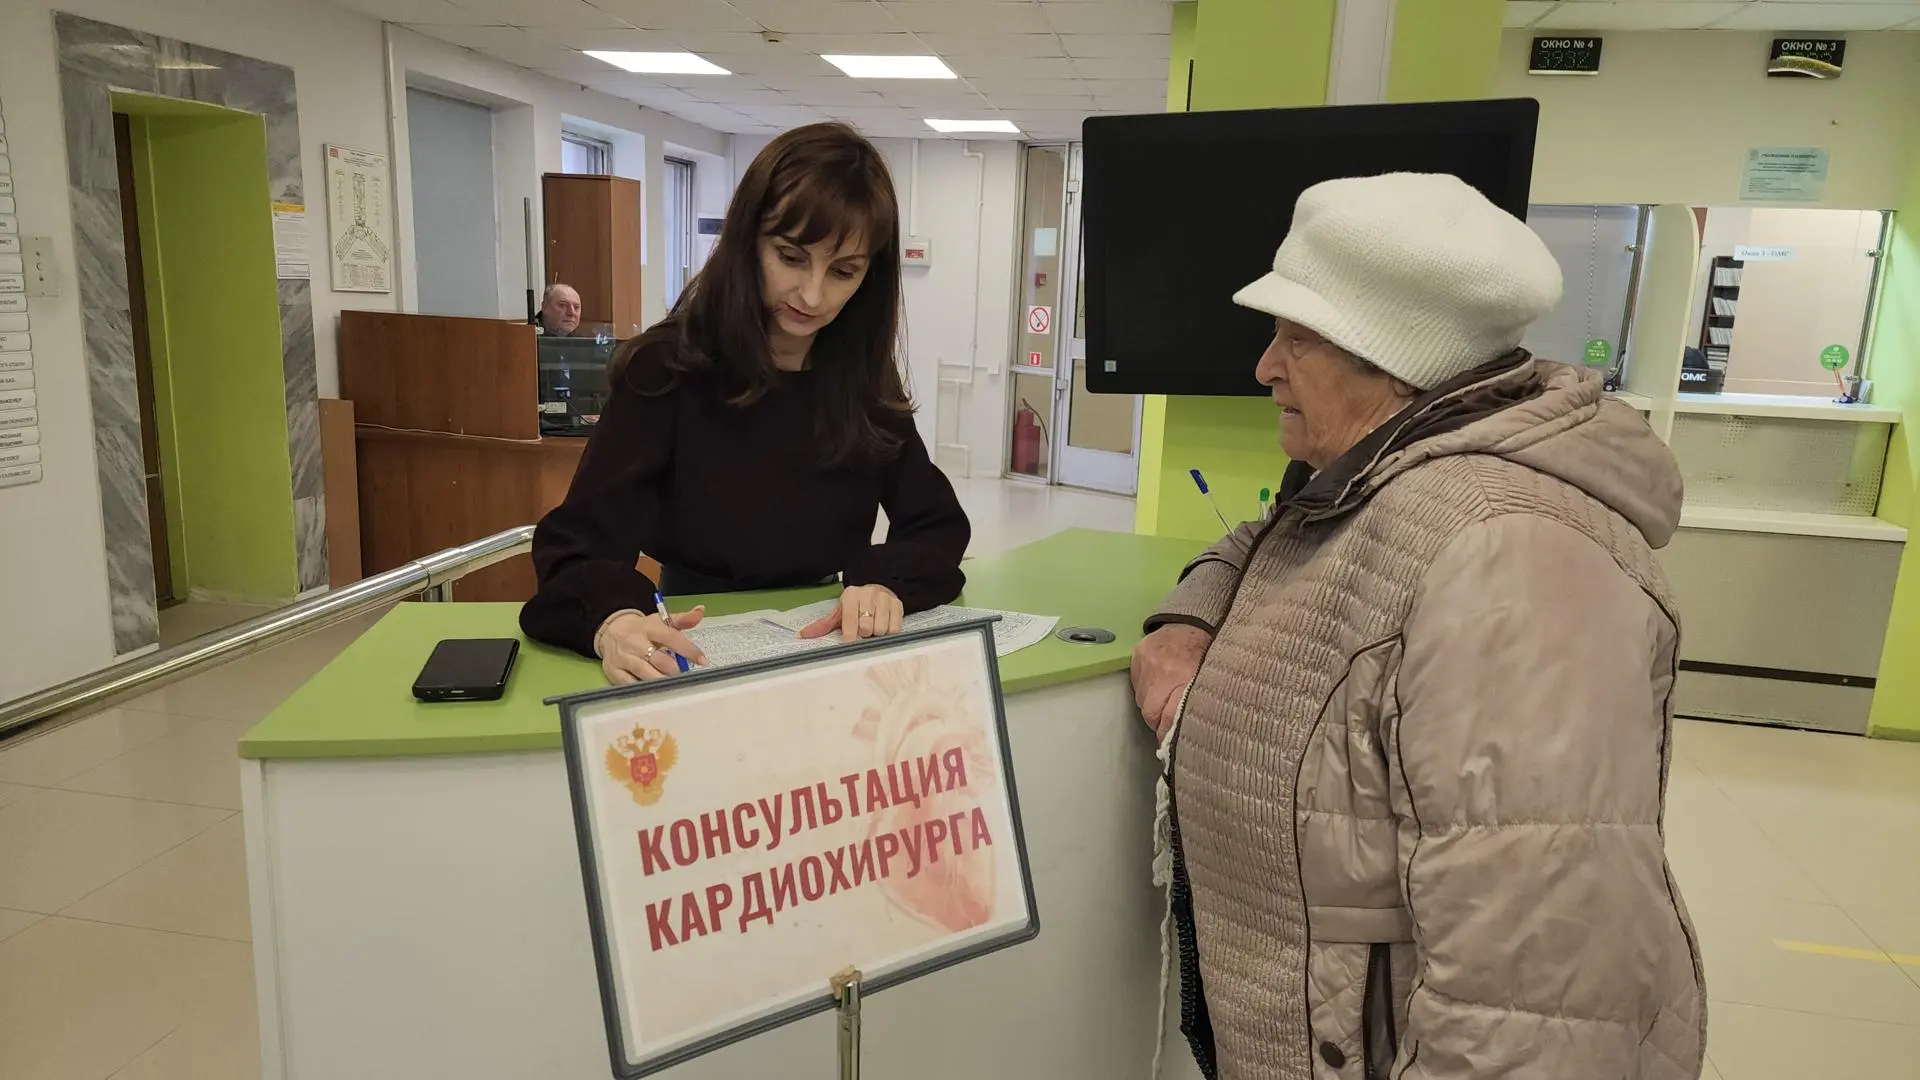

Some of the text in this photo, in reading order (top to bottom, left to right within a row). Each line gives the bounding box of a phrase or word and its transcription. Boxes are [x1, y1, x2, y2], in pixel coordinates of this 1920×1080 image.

[1541, 39, 1571, 49] ОКНО
[1587, 40, 1594, 49] 4
[1781, 41, 1813, 51] ОКНО
[1830, 42, 1837, 51] 3
[1680, 372, 1707, 382] ОМС
[637, 746, 969, 876] КОНСУЛЬТАЦИЯ
[645, 806, 993, 952] КАРДИОХИРУРГА
